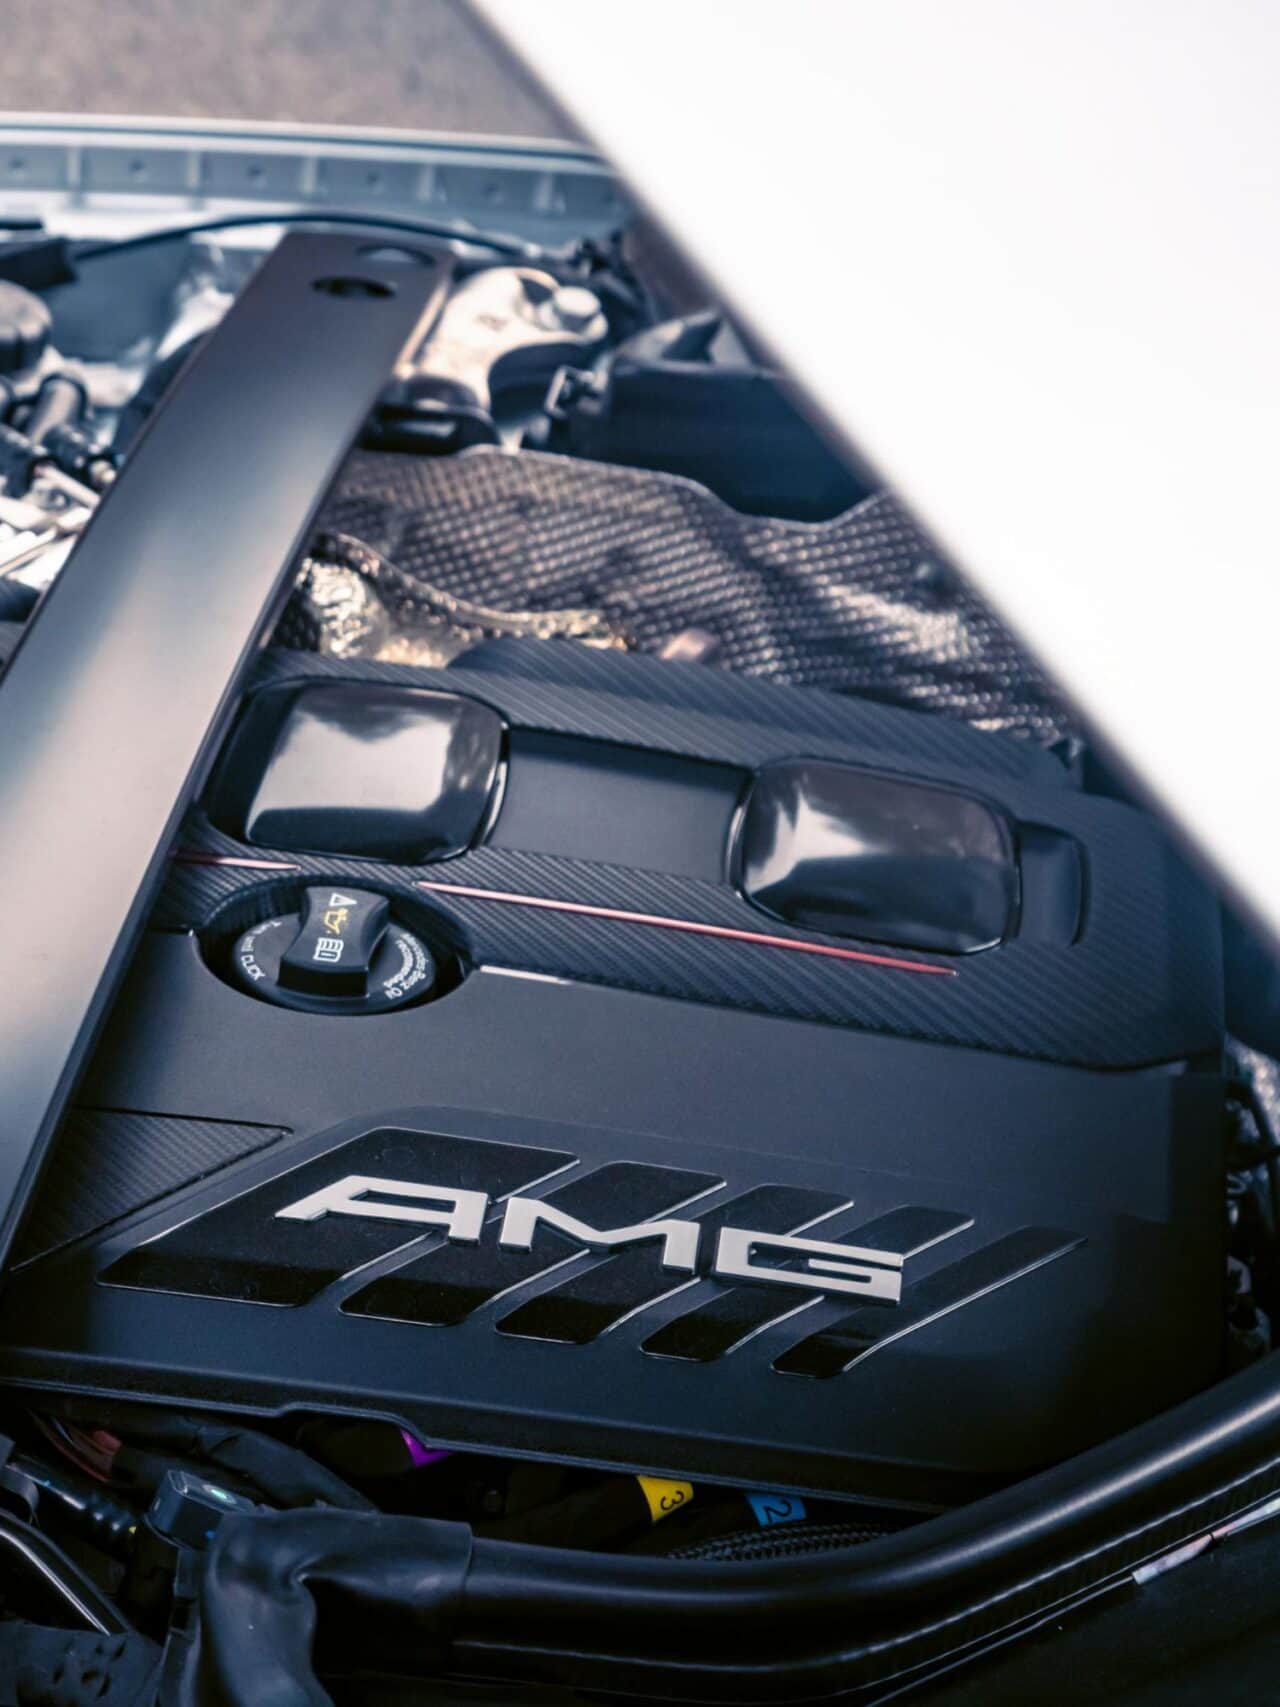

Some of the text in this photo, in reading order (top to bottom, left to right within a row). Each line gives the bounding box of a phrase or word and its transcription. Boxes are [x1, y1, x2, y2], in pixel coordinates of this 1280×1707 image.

[240, 953, 266, 981] CLICK
[274, 1174, 905, 1305] AMG
[660, 1490, 685, 1512] 3
[763, 1498, 793, 1524] 2
